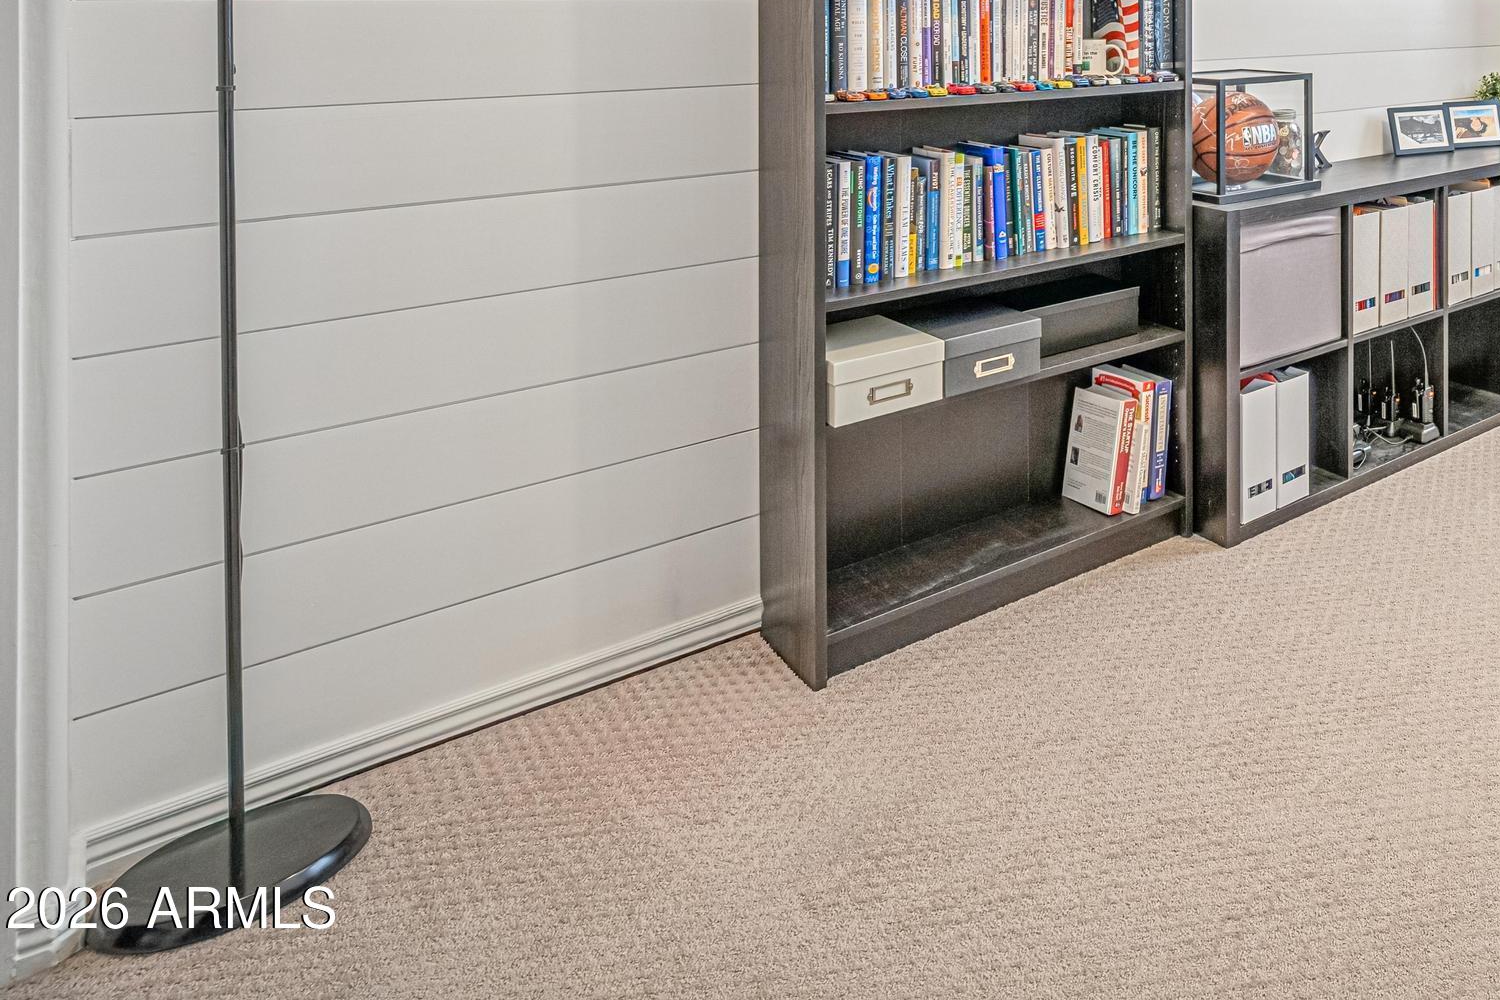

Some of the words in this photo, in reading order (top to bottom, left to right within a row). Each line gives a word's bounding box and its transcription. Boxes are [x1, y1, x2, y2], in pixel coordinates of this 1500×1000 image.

[838, 42, 844, 51] RO
[1252, 124, 1276, 144] NBA
[1132, 140, 1137, 149] BE
[956, 177, 962, 186] EQ
[1070, 182, 1077, 197] WE
[1157, 396, 1168, 451] INVESTMENTS
[1125, 422, 1134, 453] STARTUP
